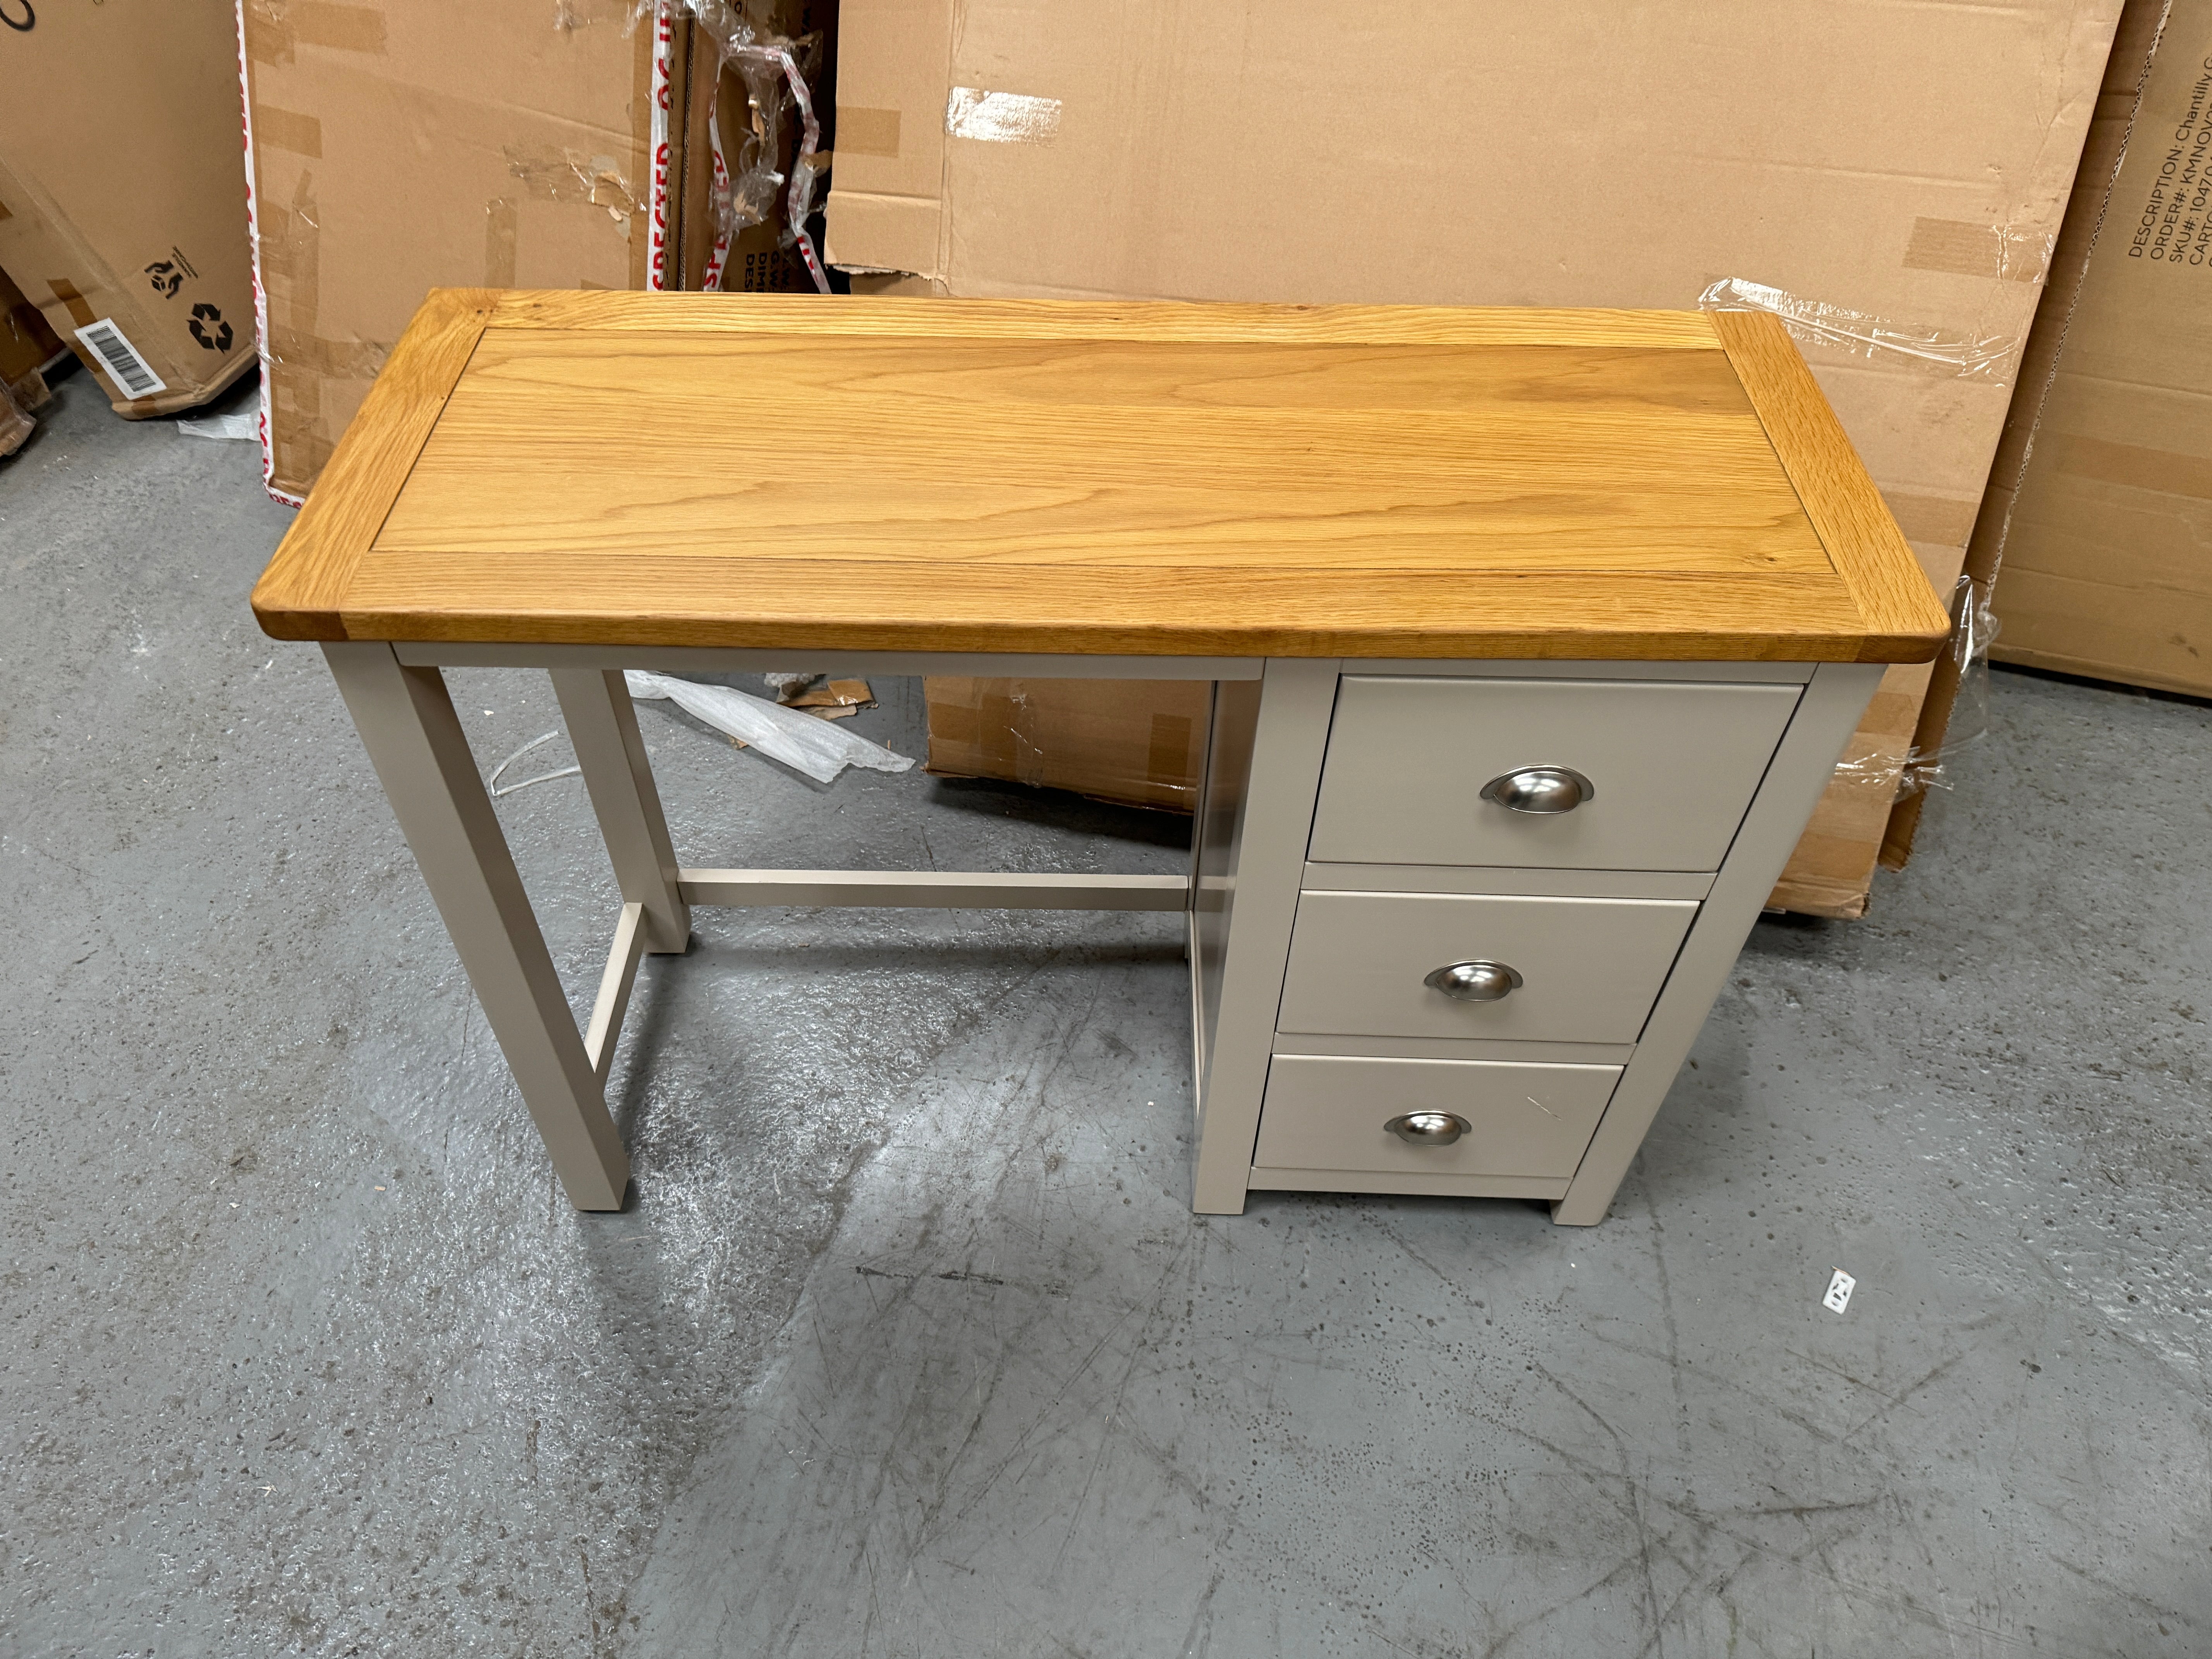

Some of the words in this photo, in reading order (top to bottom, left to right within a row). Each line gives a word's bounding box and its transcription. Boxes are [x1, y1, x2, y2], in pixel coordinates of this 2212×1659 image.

[2128, 144, 2185, 257] DESCRIPTION:
[2176, 73, 2212, 141] Chantilly
[2150, 188, 2190, 259] ORDER#:
[2169, 216, 2199, 263] SKU#:
[744, 254, 755, 292] DES
